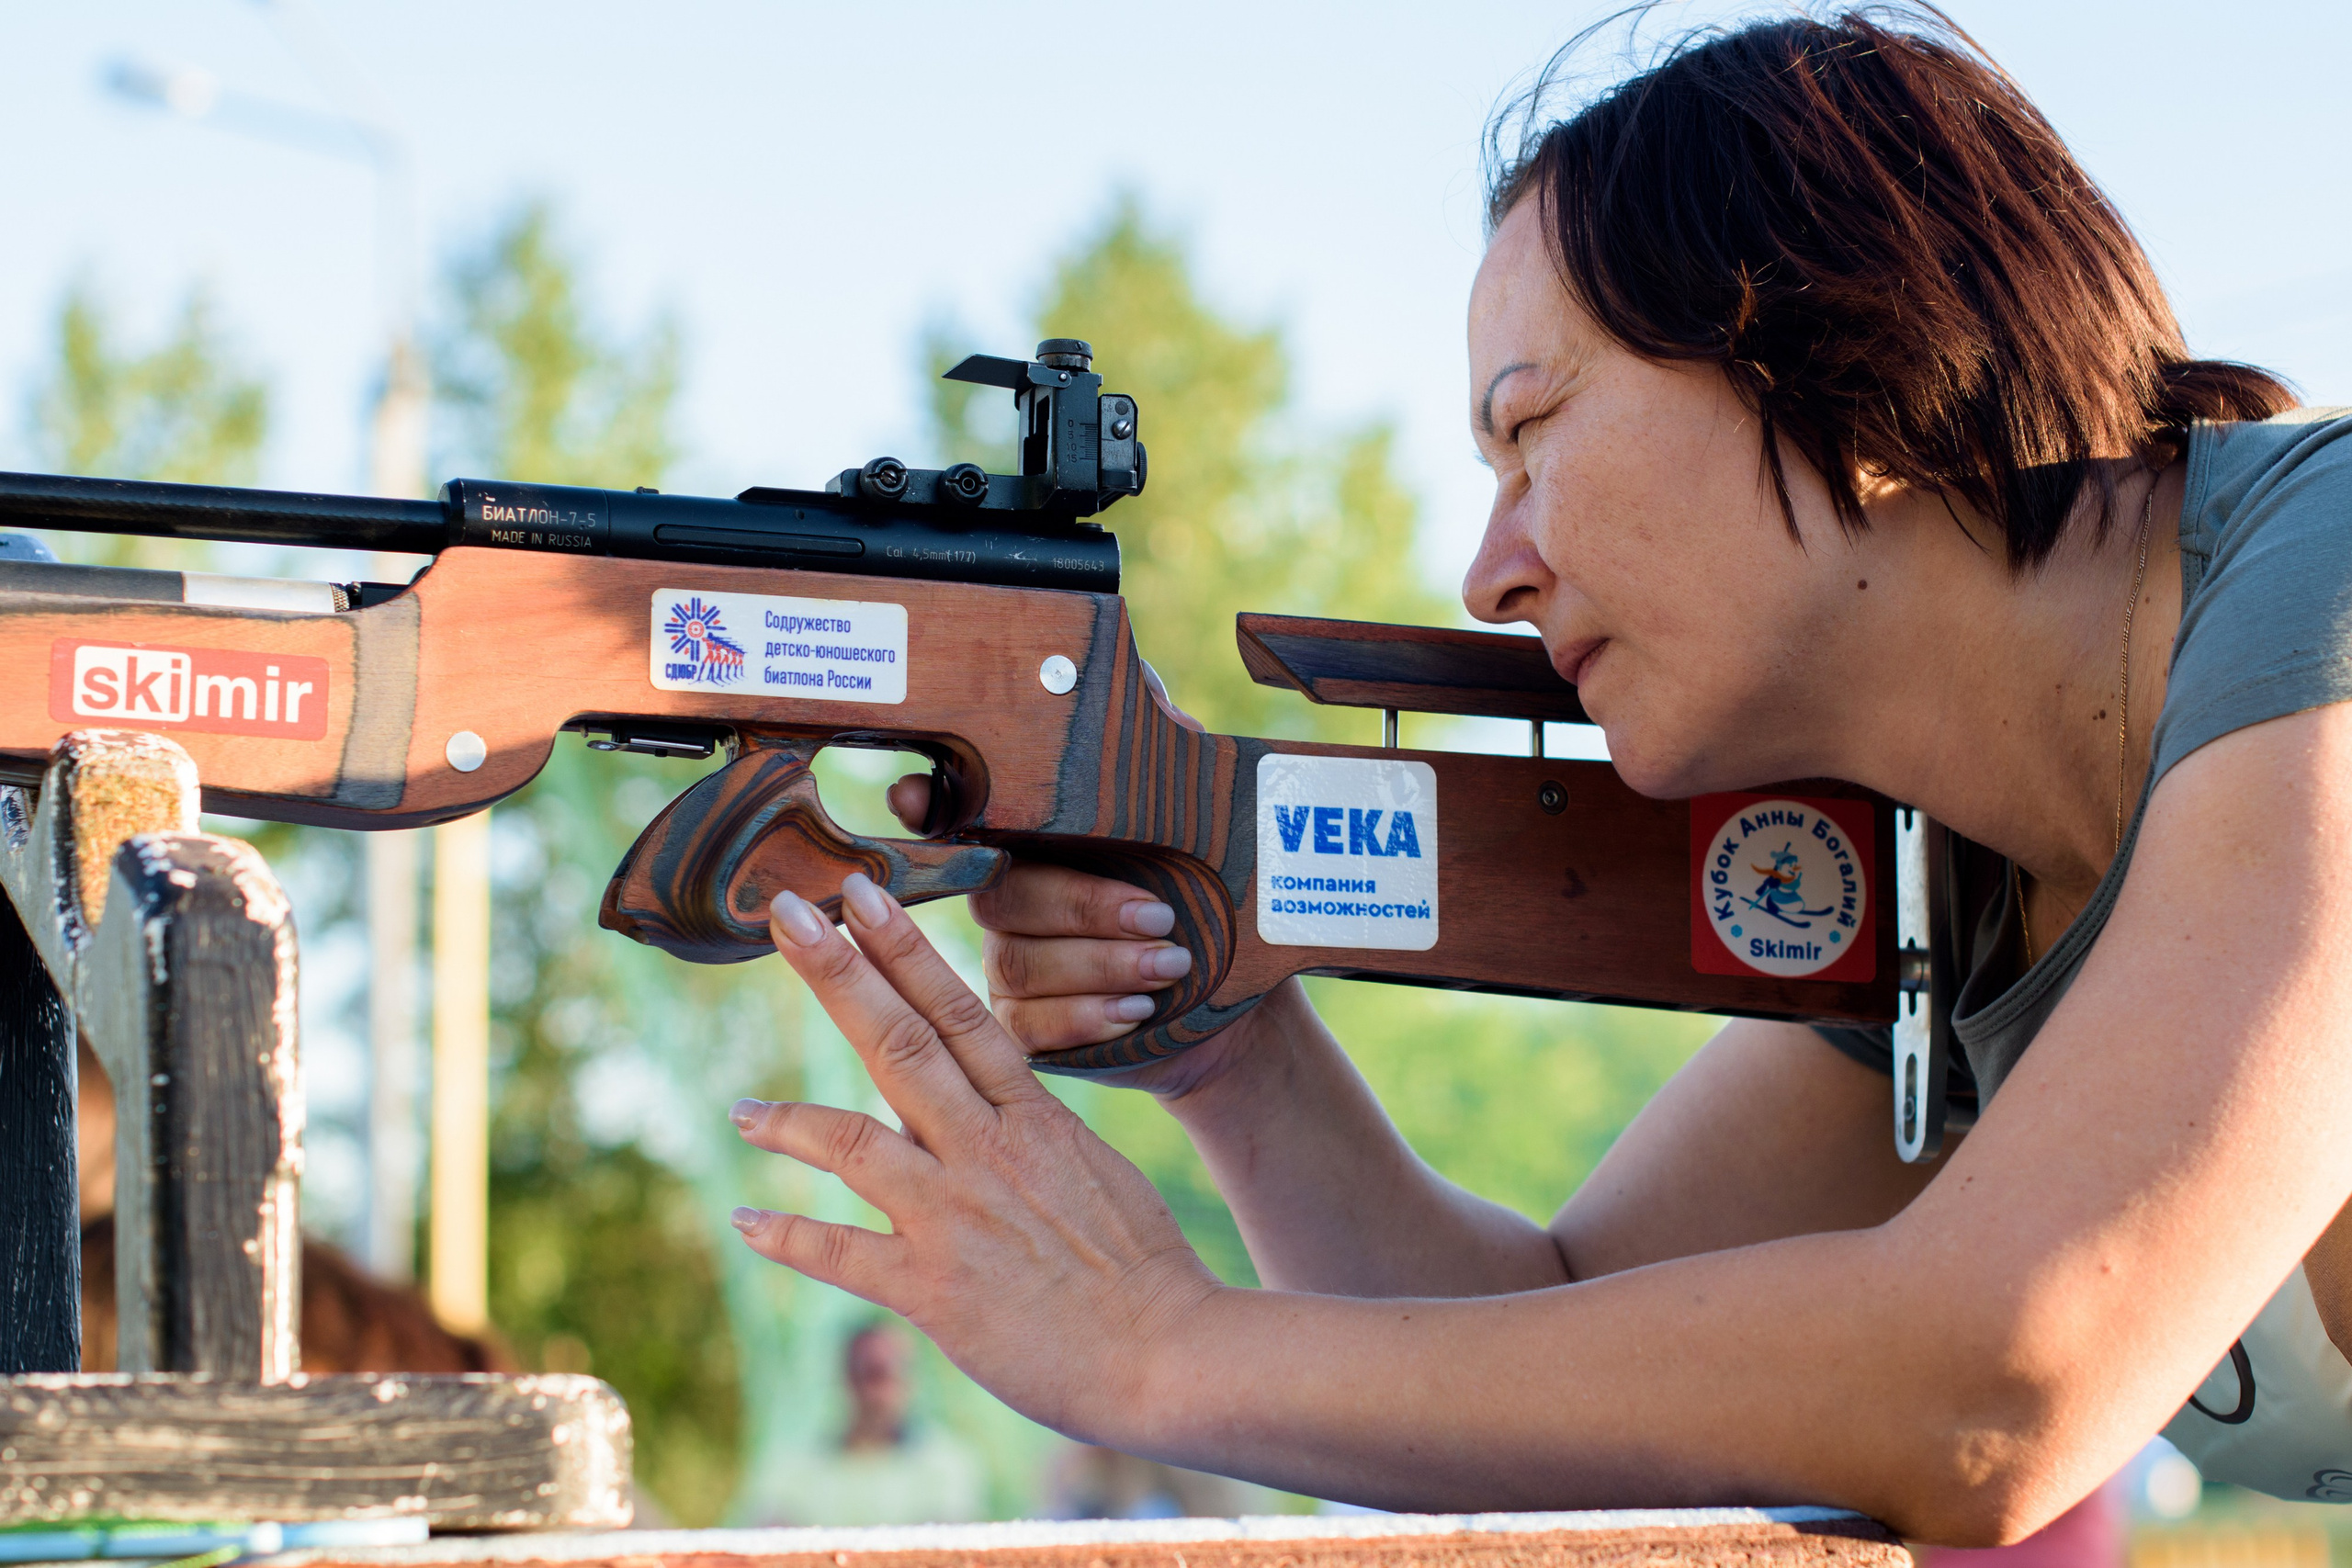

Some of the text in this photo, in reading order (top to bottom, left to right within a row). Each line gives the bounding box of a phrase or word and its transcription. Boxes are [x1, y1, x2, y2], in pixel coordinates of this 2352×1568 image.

[1068, 431, 1074, 440] 5
[482, 505, 596, 527] БИАТЛОН-7-5
[492, 530, 592, 547] MADE IN RUSSIA
[886, 546, 907, 558] Cal.
[1052, 558, 1104, 571] 18005643
[764, 610, 851, 633] Содружество
[764, 642, 896, 663] детско-юношеского
[665, 662, 697, 681] СДЮБР
[763, 667, 872, 690] биатлона России
[81, 655, 312, 723] skimir
[1273, 804, 1421, 858] VEKA
[1710, 810, 1857, 929] Кубок Анны Богалий
[1271, 875, 1375, 894] компания
[1271, 898, 1430, 919] возможностей
[1749, 938, 1822, 960] Skimir
